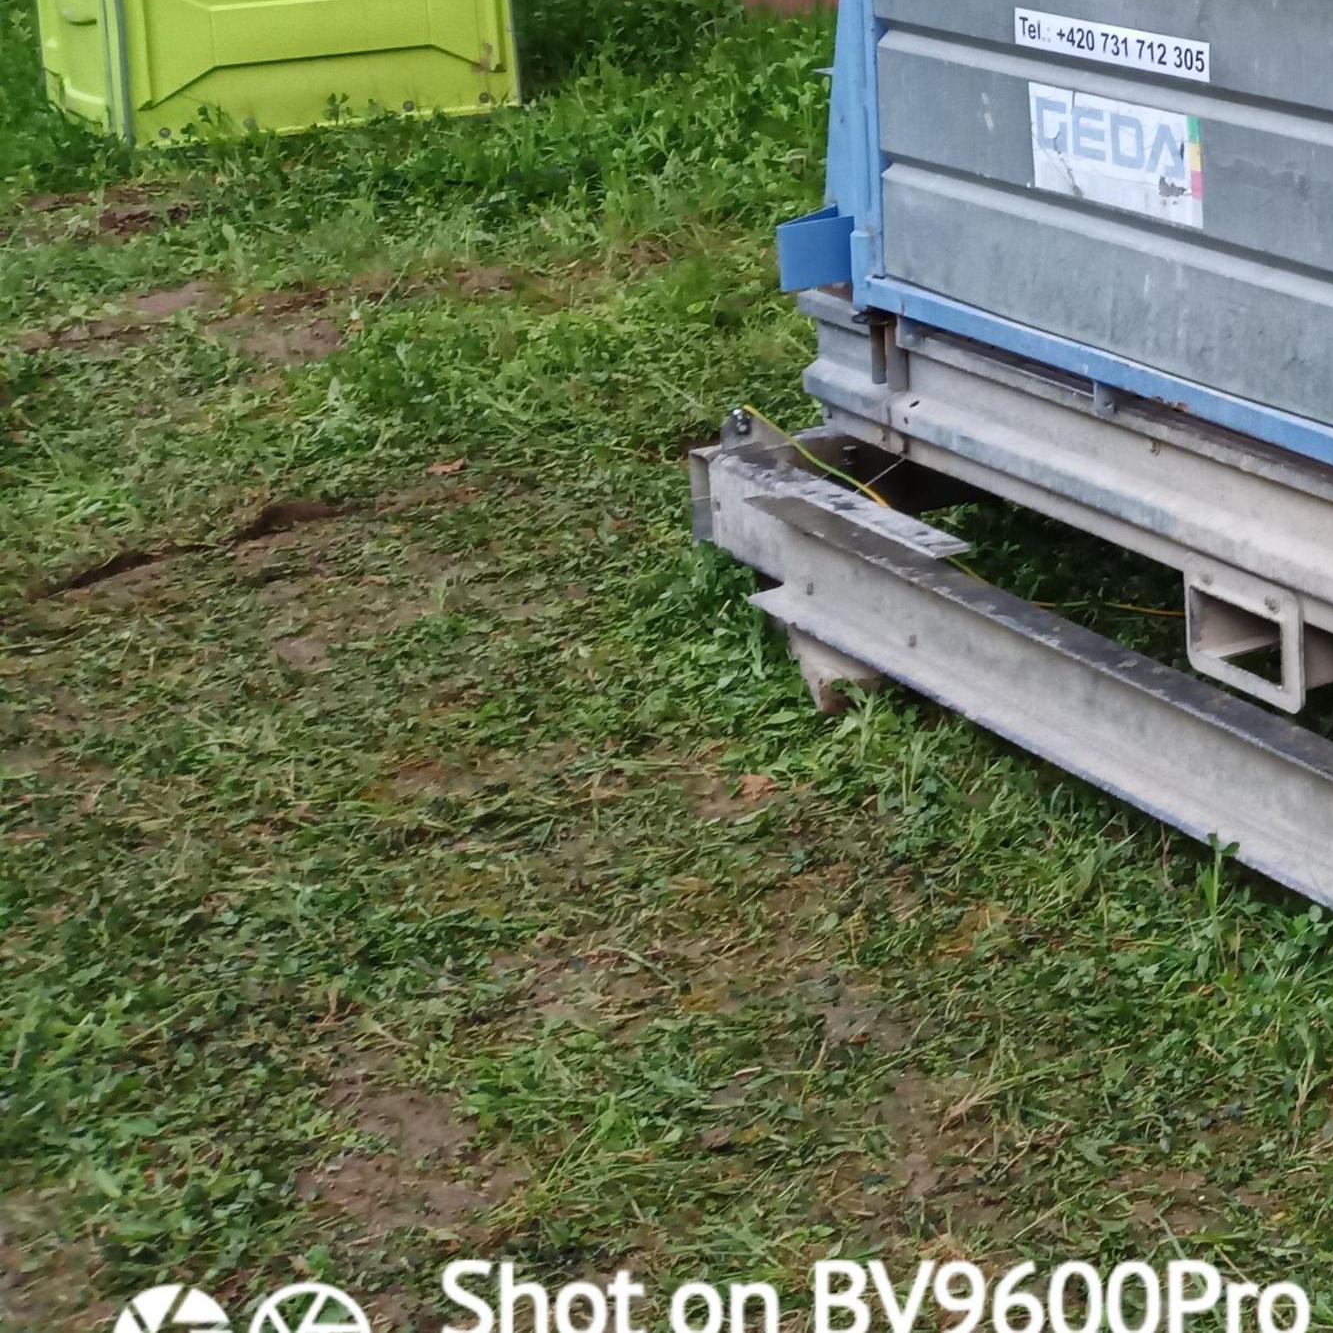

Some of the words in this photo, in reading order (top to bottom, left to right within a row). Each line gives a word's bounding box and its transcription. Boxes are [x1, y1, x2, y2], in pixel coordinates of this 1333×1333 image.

[1057, 26, 1095, 52] +420
[1101, 33, 1129, 57] 731
[1136, 39, 1167, 66] 712
[1174, 46, 1205, 73] 305
[1035, 96, 1186, 180] GEDA
